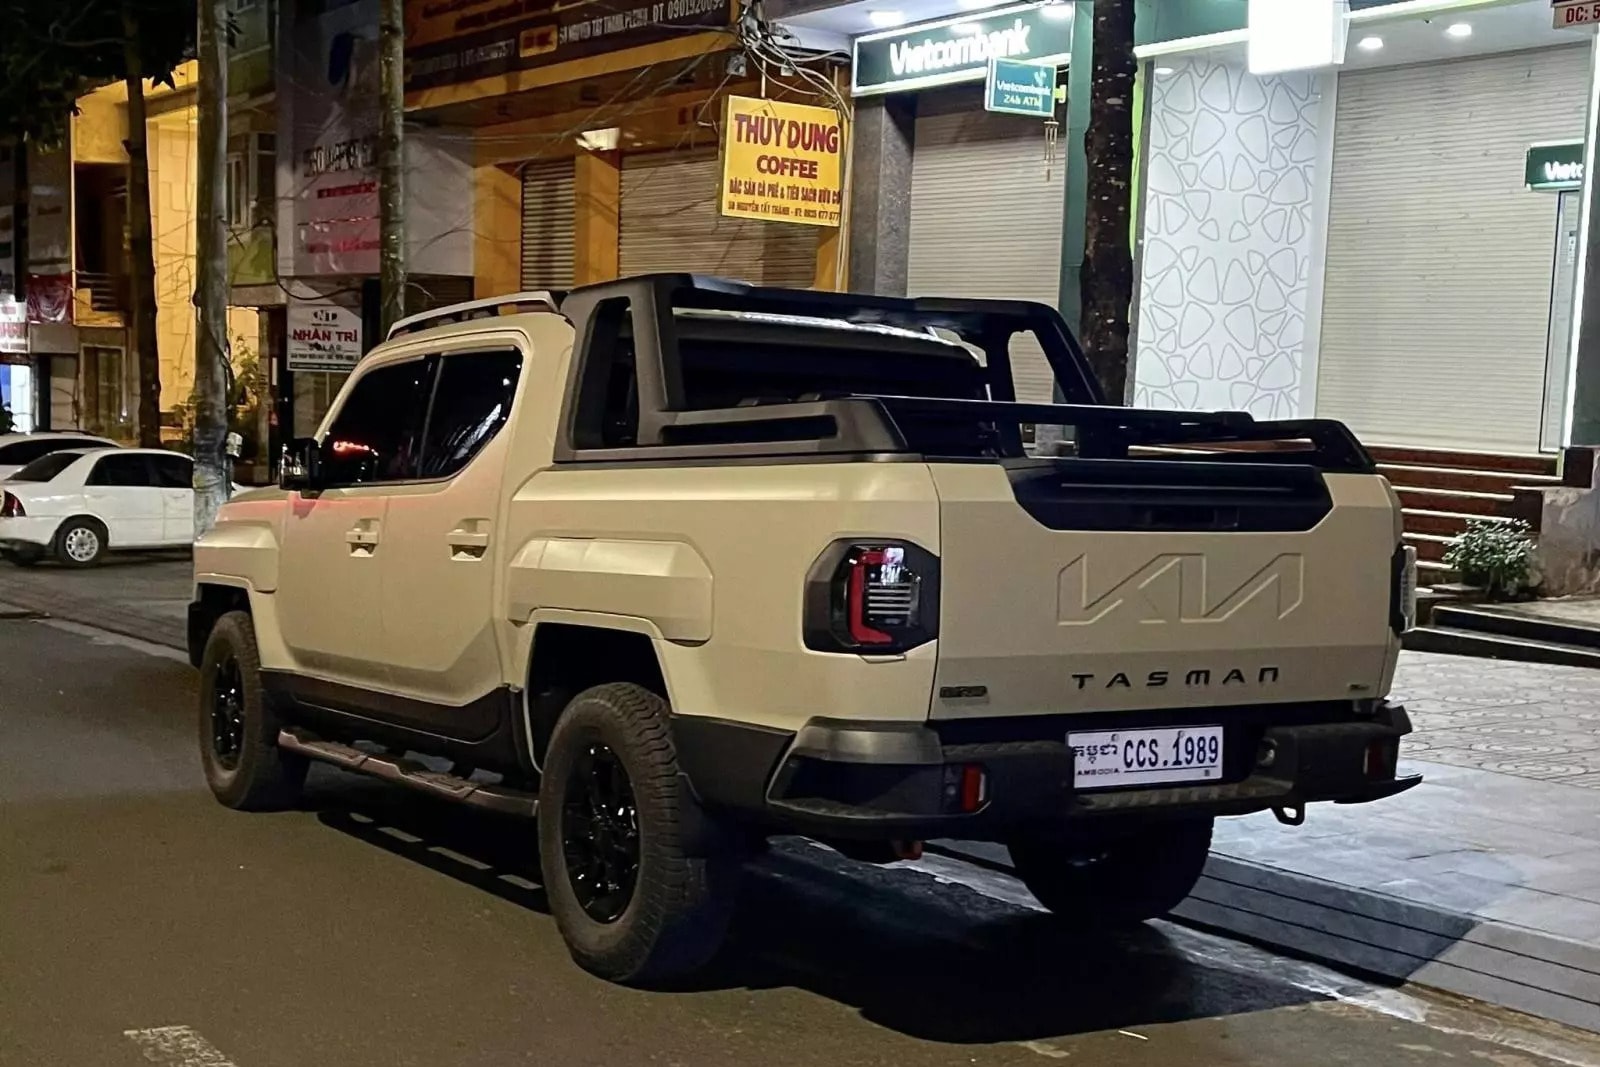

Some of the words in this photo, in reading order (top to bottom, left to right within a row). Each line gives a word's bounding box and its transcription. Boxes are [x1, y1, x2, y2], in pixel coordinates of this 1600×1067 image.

[889, 18, 1030, 75] Vietcombank
[996, 80, 1051, 96] Vietcombank
[735, 109, 785, 147] THÙY
[787, 120, 838, 154] DUNG
[756, 155, 818, 179] COFFEE
[1071, 667, 1279, 690] TASMAN
[1123, 735, 1219, 769] CCS.1989
